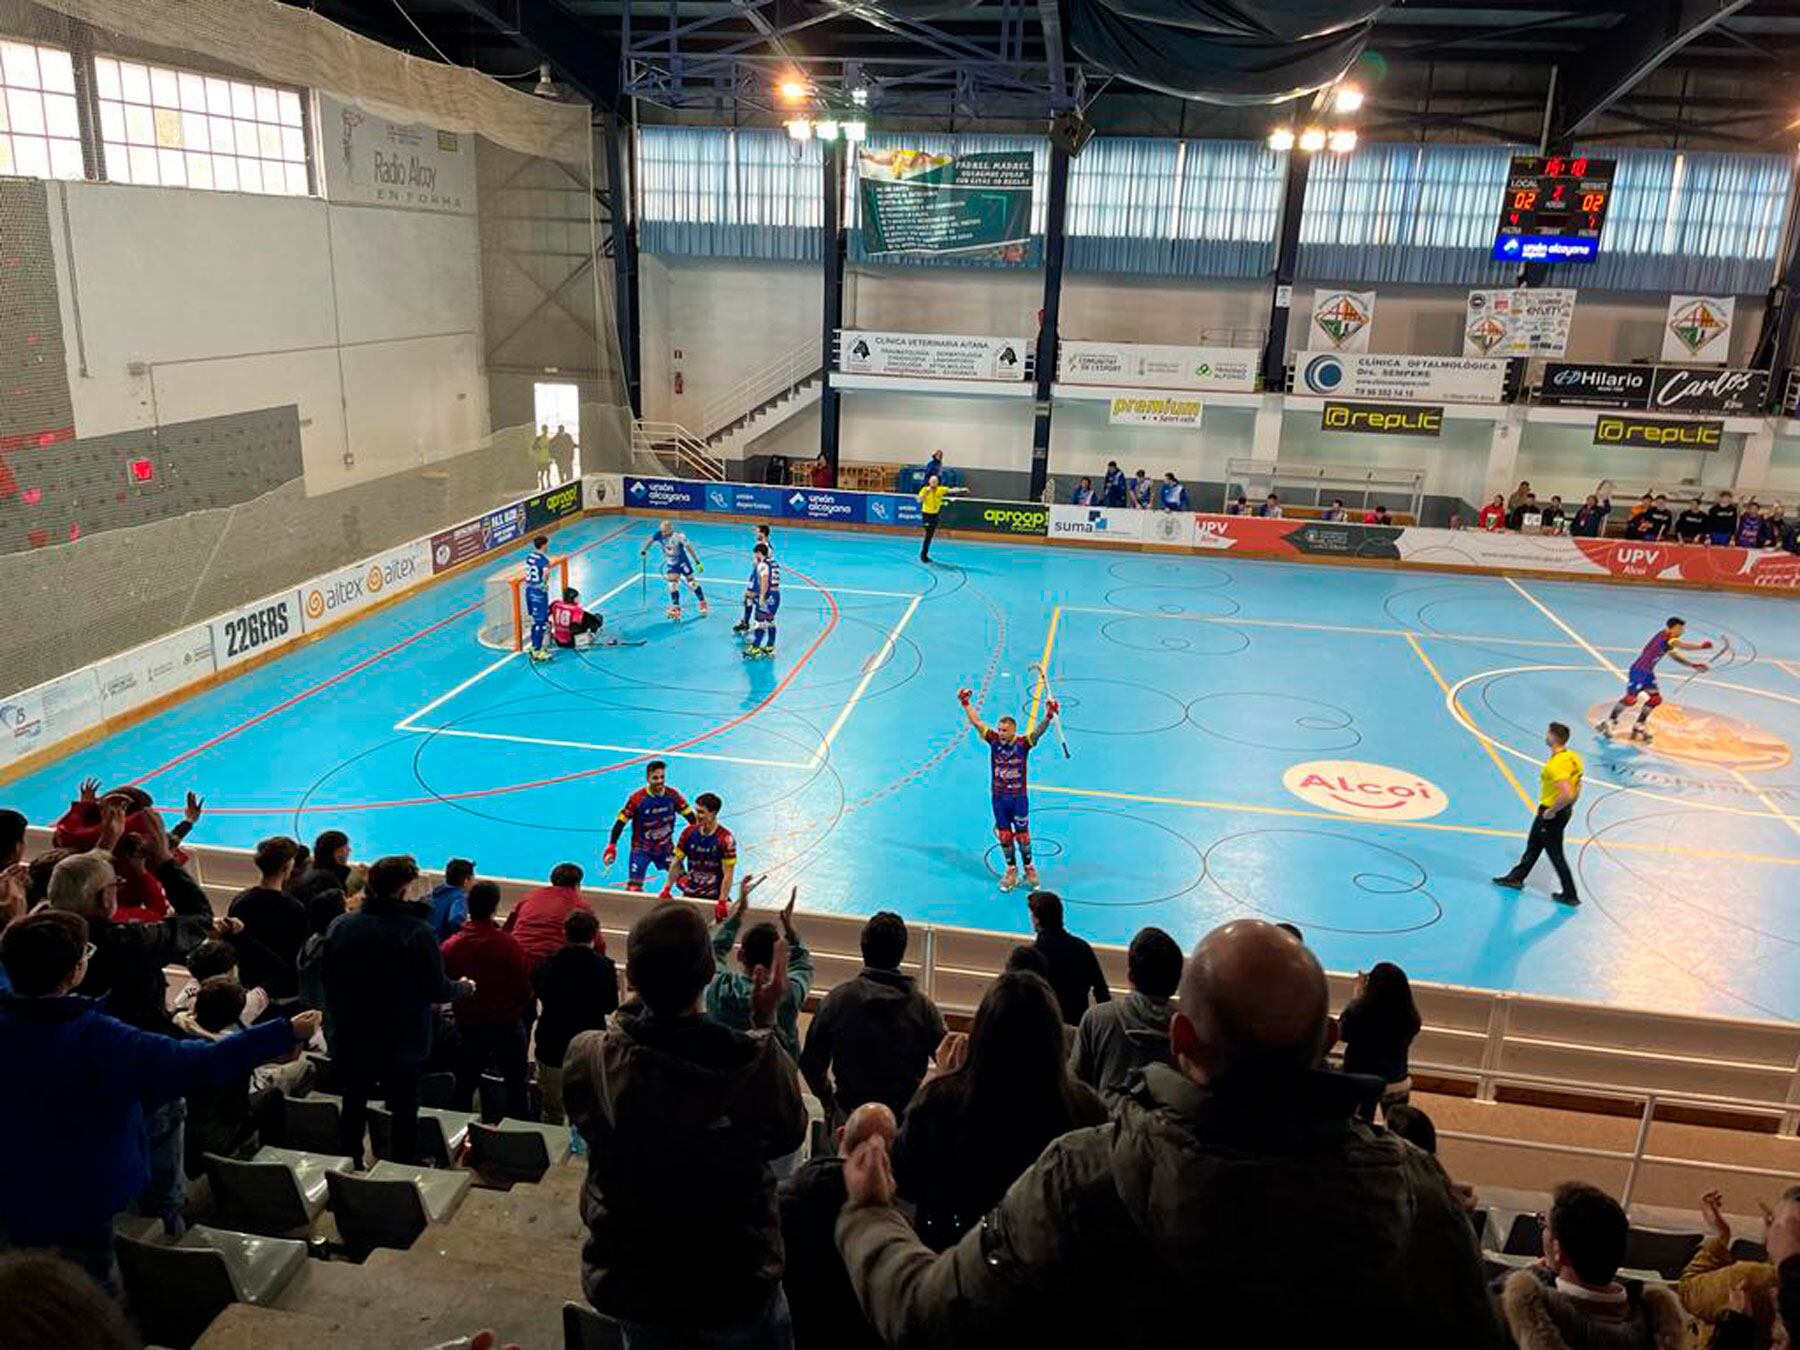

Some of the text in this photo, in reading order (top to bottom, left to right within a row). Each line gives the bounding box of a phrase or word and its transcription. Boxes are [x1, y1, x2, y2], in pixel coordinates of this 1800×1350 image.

[374, 149, 405, 186] Radio
[1510, 179, 1538, 188] LOCAL
[1513, 192, 1604, 212] 02 02
[908, 338, 958, 348] VETERINARIA
[1358, 358, 1498, 371] CLÍNICA OFTALMOLÓGICA
[1382, 370, 1432, 378] SEMPERE
[1581, 370, 1644, 389] Hilario
[1656, 371, 1753, 406] Carlos
[1112, 397, 1201, 417] premium
[1350, 411, 1442, 431] replic
[1625, 425, 1720, 445] replic
[648, 482, 674, 493] unión
[648, 491, 691, 503] alcoyana
[808, 494, 835, 504] unión
[808, 502, 852, 515] alcoyana
[983, 508, 1050, 526] aproop!
[1053, 520, 1094, 534] suma
[1195, 521, 1228, 535] UPV
[1616, 547, 1660, 565] UPV
[384, 555, 417, 585] aitex
[326, 576, 364, 610] aitex
[224, 601, 289, 657] 226ERS
